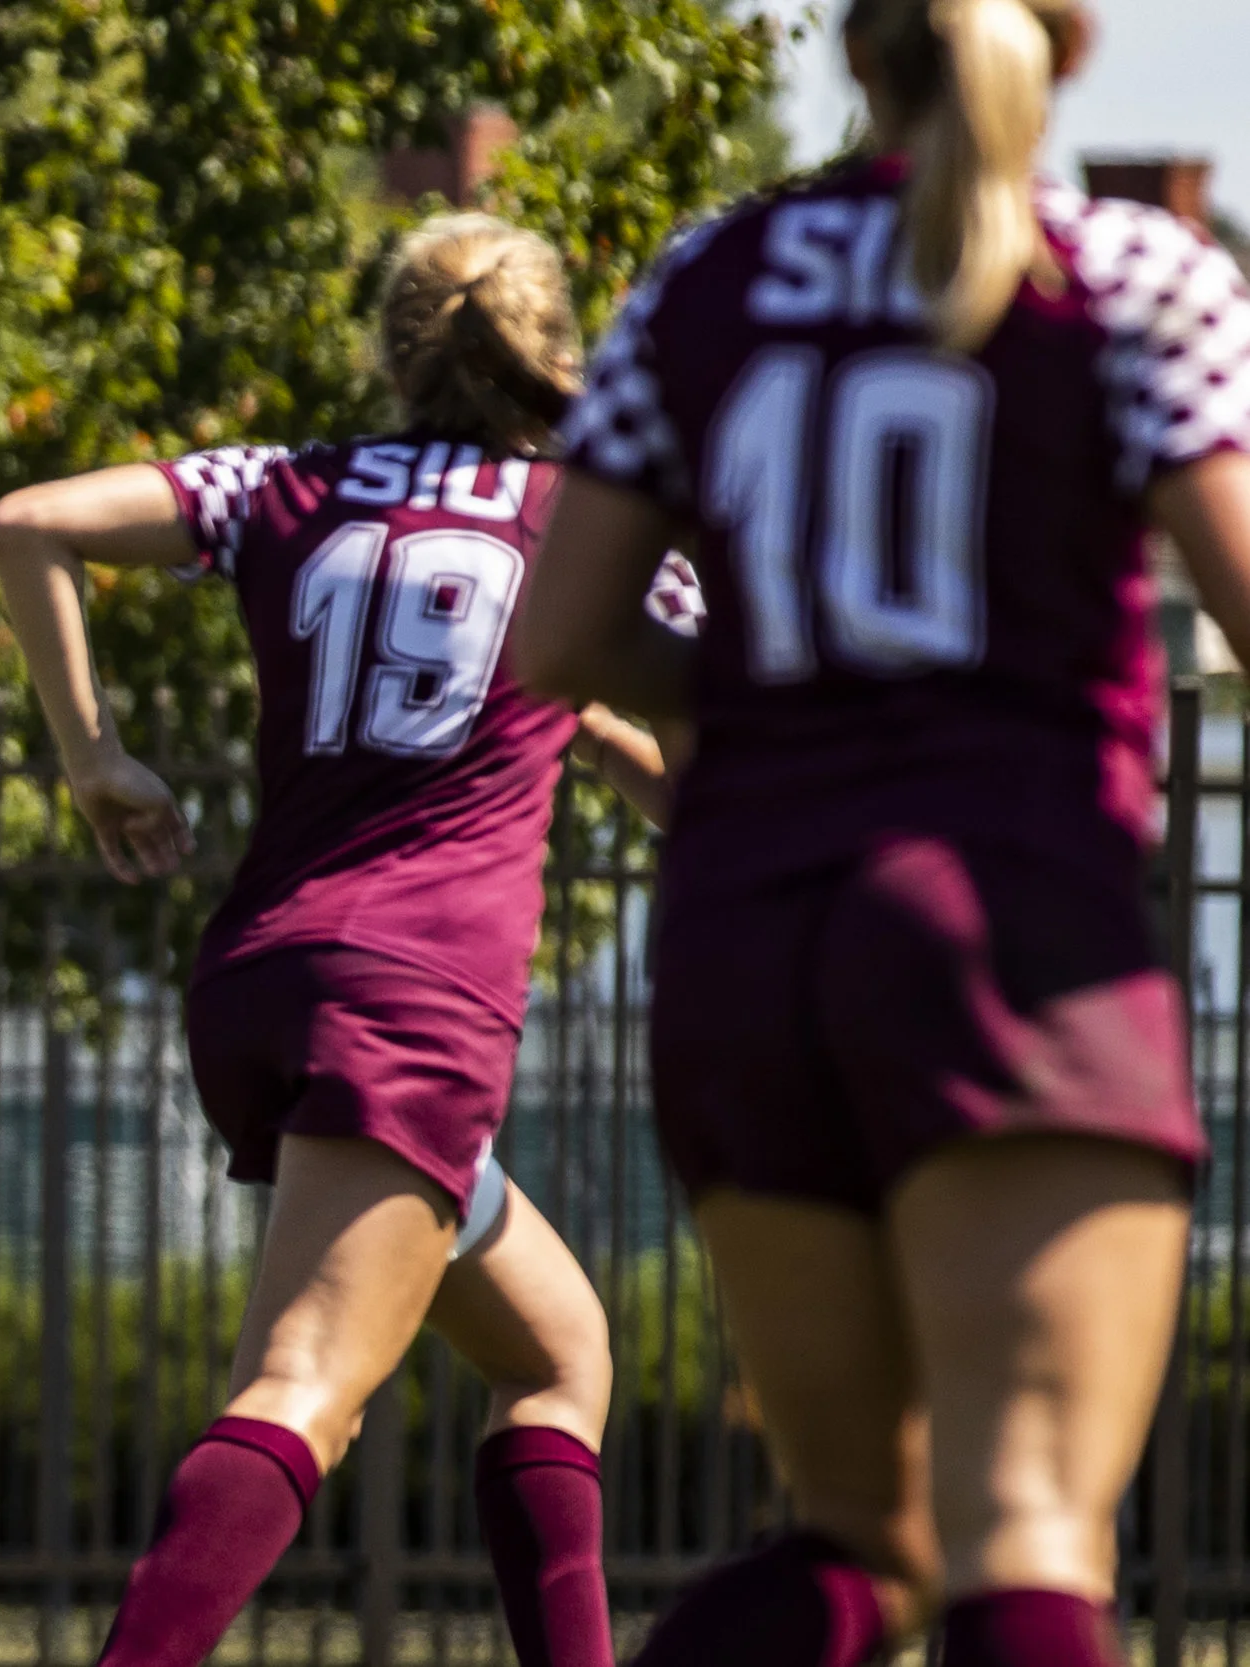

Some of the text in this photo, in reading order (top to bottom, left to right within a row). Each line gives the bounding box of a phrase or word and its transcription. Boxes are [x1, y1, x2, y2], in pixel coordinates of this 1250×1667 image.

[748, 196, 930, 327] SI
[335, 442, 530, 522] SIU
[700, 343, 996, 686] 10
[290, 521, 524, 757] 19
